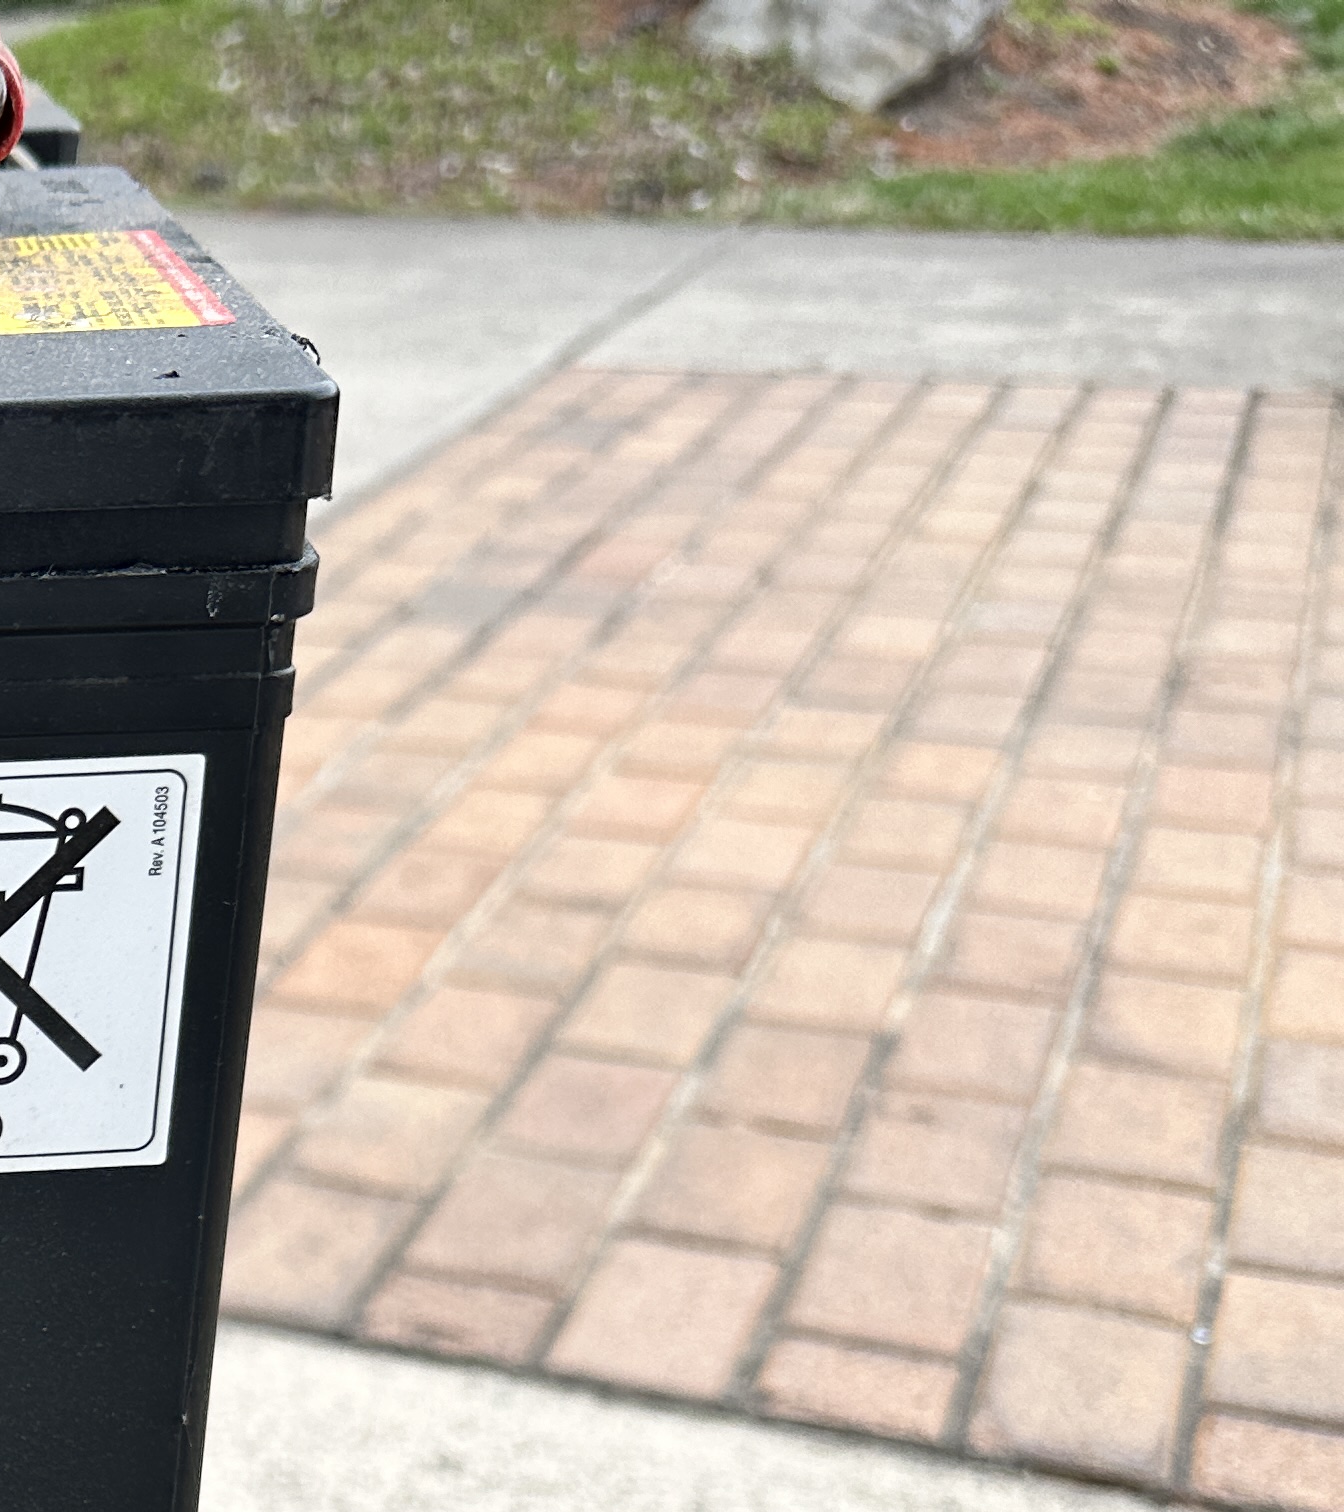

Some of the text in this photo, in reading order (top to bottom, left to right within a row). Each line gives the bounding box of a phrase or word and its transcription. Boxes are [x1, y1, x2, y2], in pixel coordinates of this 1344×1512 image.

[148, 786, 169, 876] Rev. A 104503
